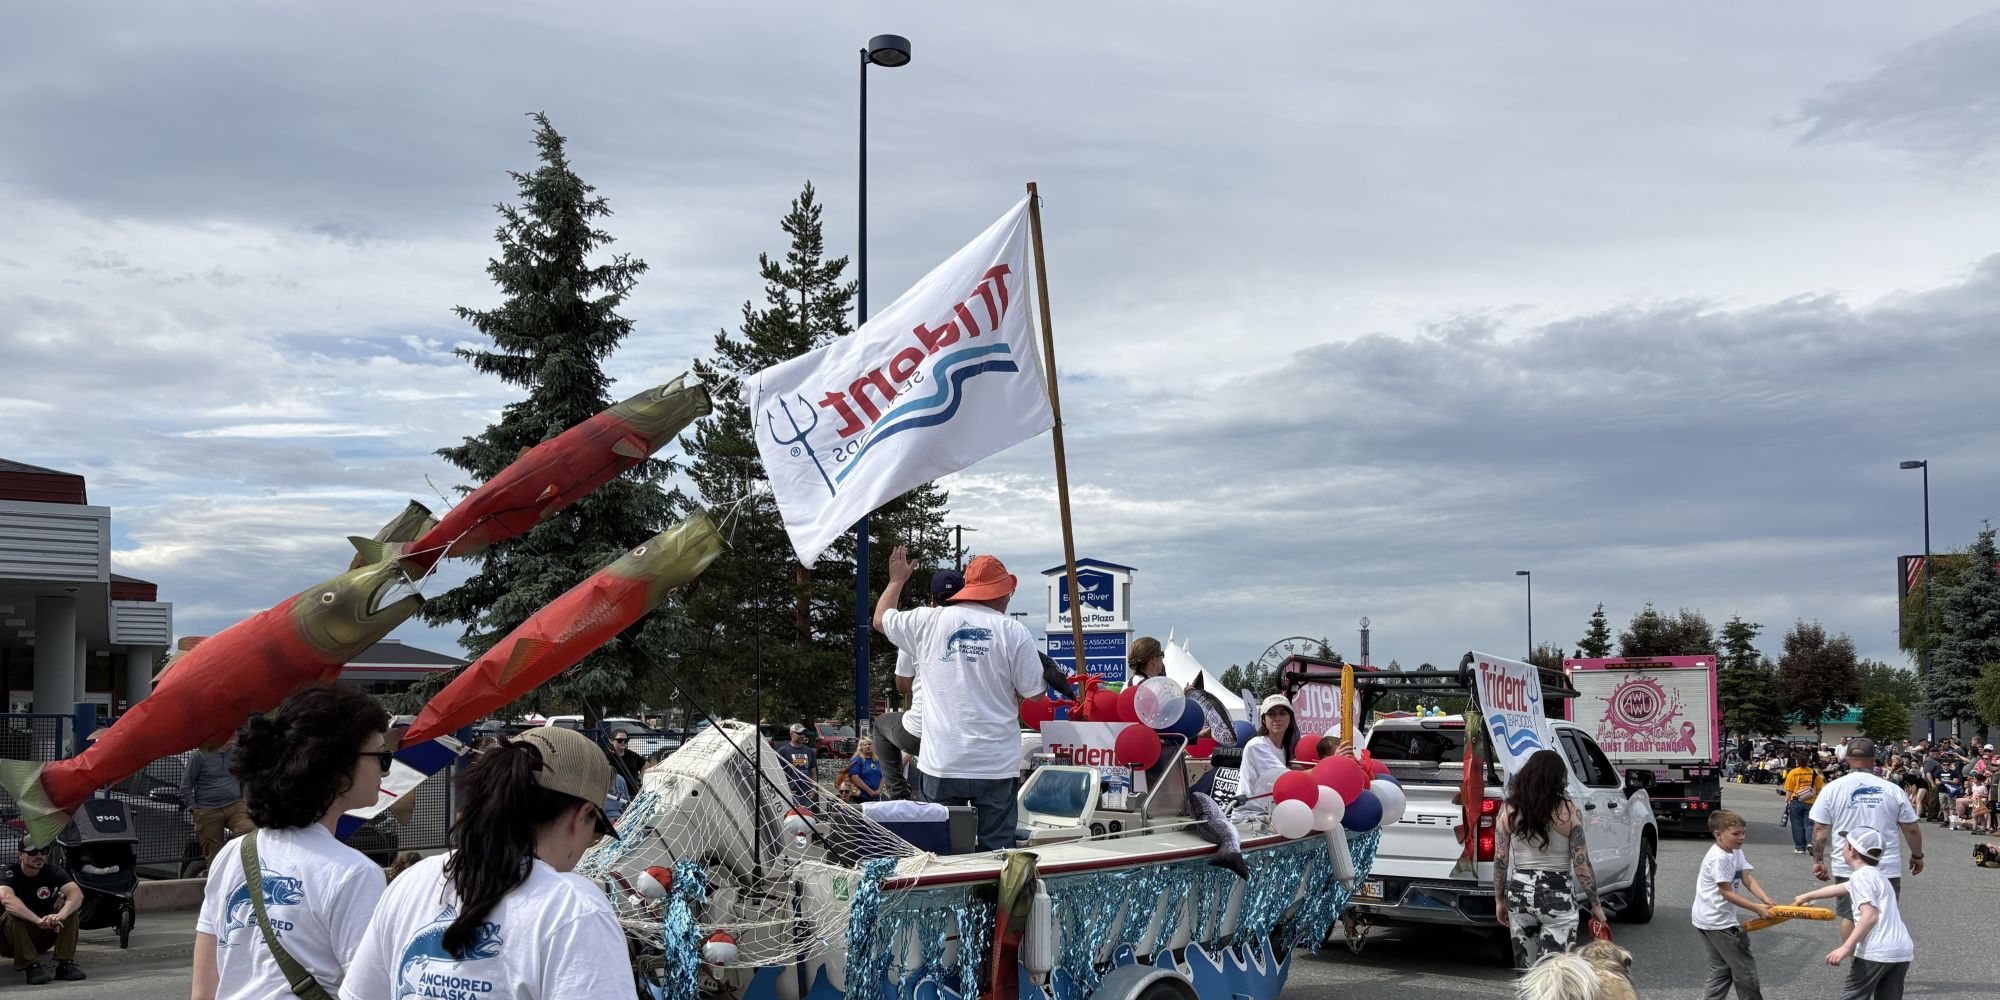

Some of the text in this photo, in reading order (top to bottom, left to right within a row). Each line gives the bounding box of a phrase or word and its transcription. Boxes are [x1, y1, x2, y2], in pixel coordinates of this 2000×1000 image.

[1063, 593, 1109, 602] Ele River
[1058, 614, 1115, 624] Mecal Plaza
[1088, 638, 1125, 646] ASSOCIATES
[1480, 662, 1528, 713] Trident
[1507, 713, 1534, 729] SEAFOODS
[1624, 741, 1653, 753] BREAST
[1655, 741, 1687, 753] CANCER
[1216, 780, 1239, 793] SEAFOO
[420, 972, 493, 993] ANCHORED
[423, 985, 478, 1000] ALASKA
